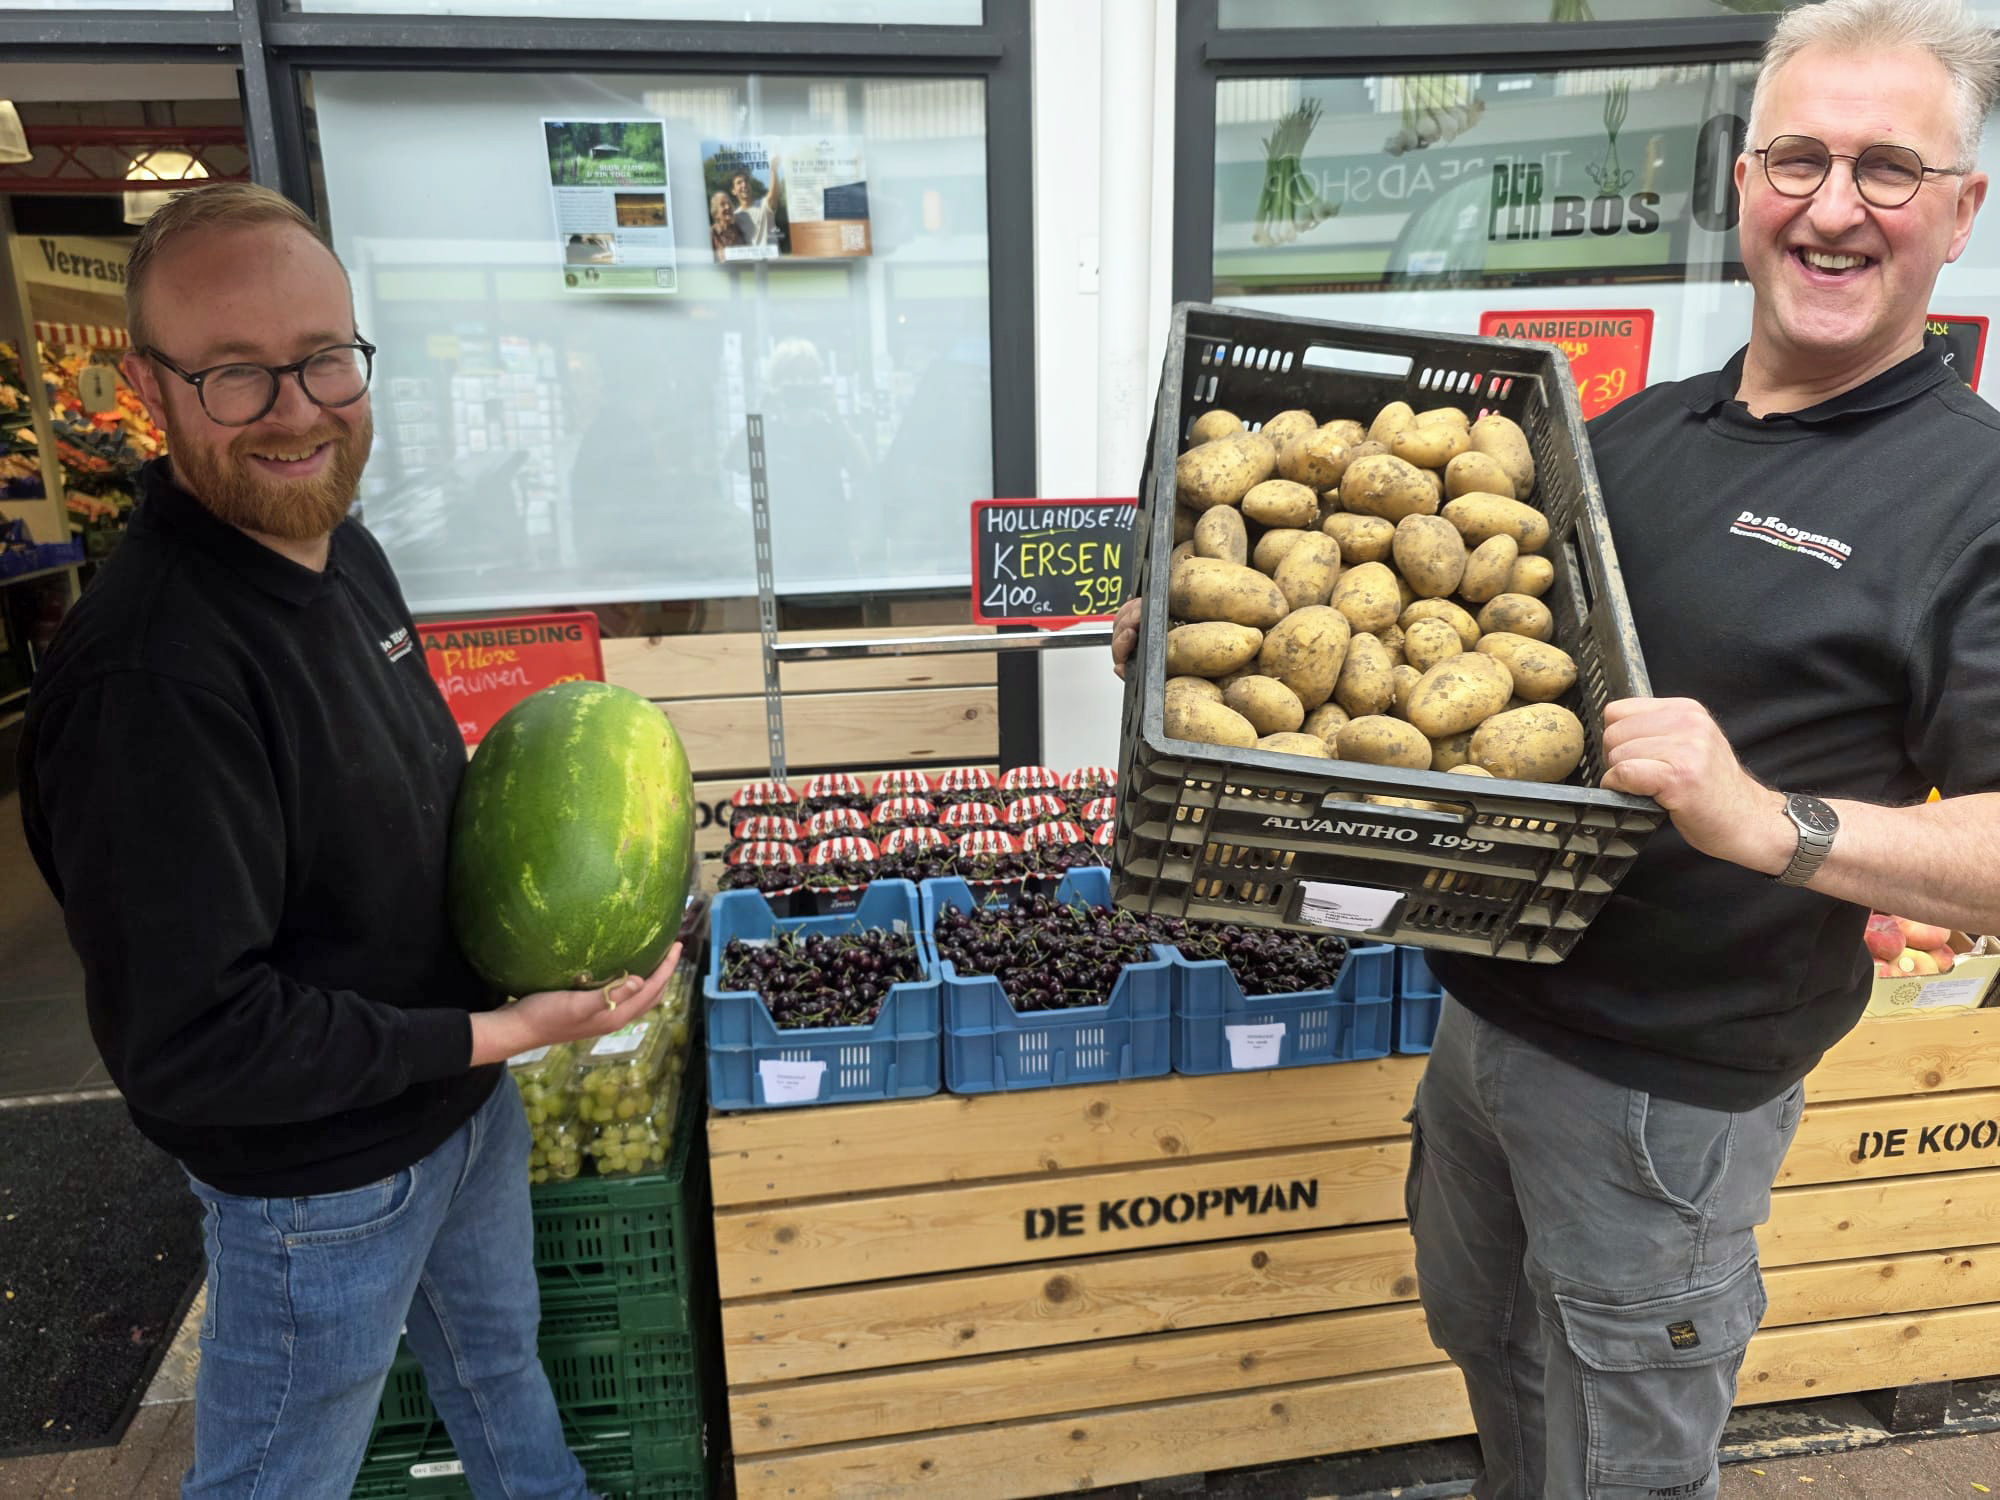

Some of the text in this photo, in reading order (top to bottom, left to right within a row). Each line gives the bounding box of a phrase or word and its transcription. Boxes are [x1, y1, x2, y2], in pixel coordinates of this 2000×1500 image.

[1550, 191, 1660, 237] BOS
[1496, 319, 1633, 339] AANBIEDING
[1737, 511, 1852, 556] De Koopman
[994, 542, 1121, 580] KERSEN
[983, 583, 1037, 616] 400
[425, 624, 582, 650] AANBIEDING
[1262, 816, 1418, 842] ALVANTHO
[1858, 1120, 2000, 1159] DE KOO
[1025, 1179, 1318, 1240] DE KOOPMAN
